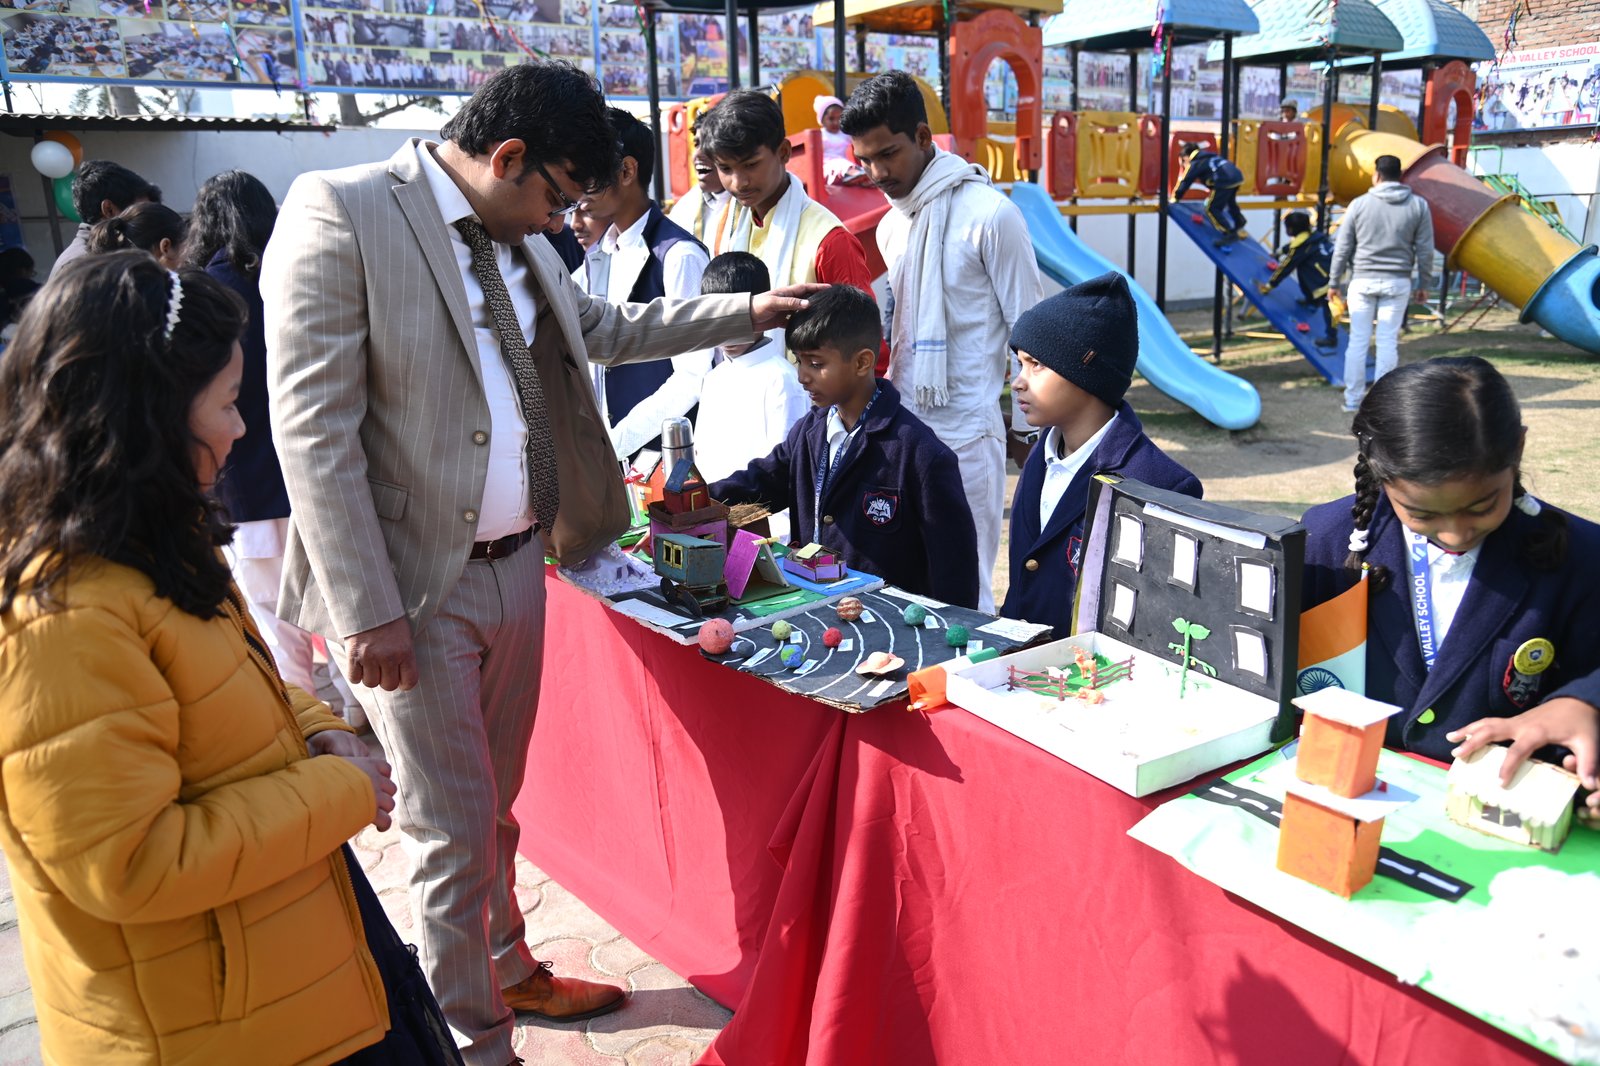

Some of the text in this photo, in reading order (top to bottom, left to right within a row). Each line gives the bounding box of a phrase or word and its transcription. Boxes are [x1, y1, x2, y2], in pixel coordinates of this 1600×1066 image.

[1519, 51, 1557, 62] VALLEY
[1559, 45, 1600, 58] SCHOOL
[816, 468, 826, 491] VALLEY
[1414, 572, 1429, 616] SCHOOL
[1419, 618, 1434, 657] VALLEY
